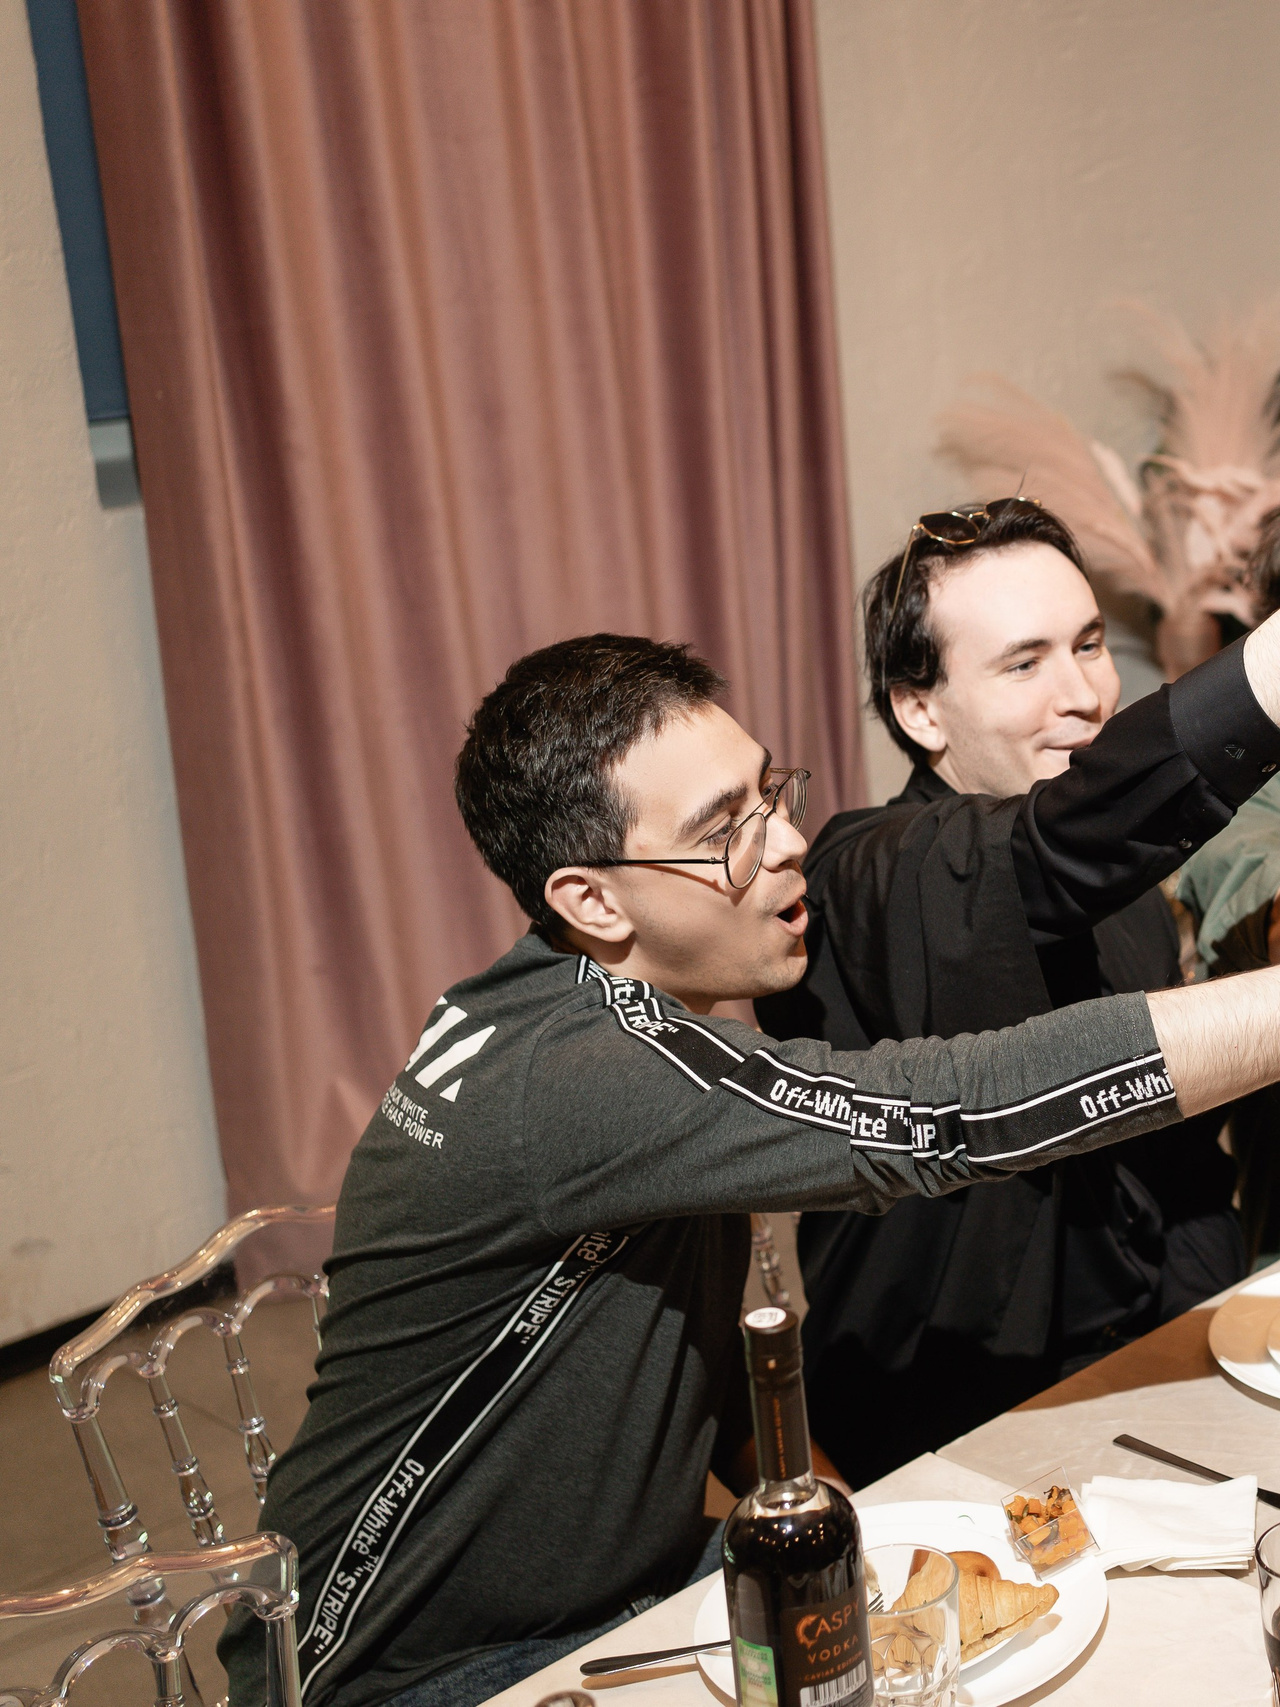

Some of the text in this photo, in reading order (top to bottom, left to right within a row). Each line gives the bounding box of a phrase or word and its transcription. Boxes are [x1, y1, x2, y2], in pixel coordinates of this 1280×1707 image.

[385, 1103, 404, 1128] HAS
[402, 1116, 444, 1150] POWER
[400, 1094, 429, 1125] WHITE
[770, 1078, 887, 1139] Off-White
[351, 1457, 426, 1556] Off-White
[795, 1597, 860, 1650] CASPY
[807, 1633, 860, 1665] VODKA
